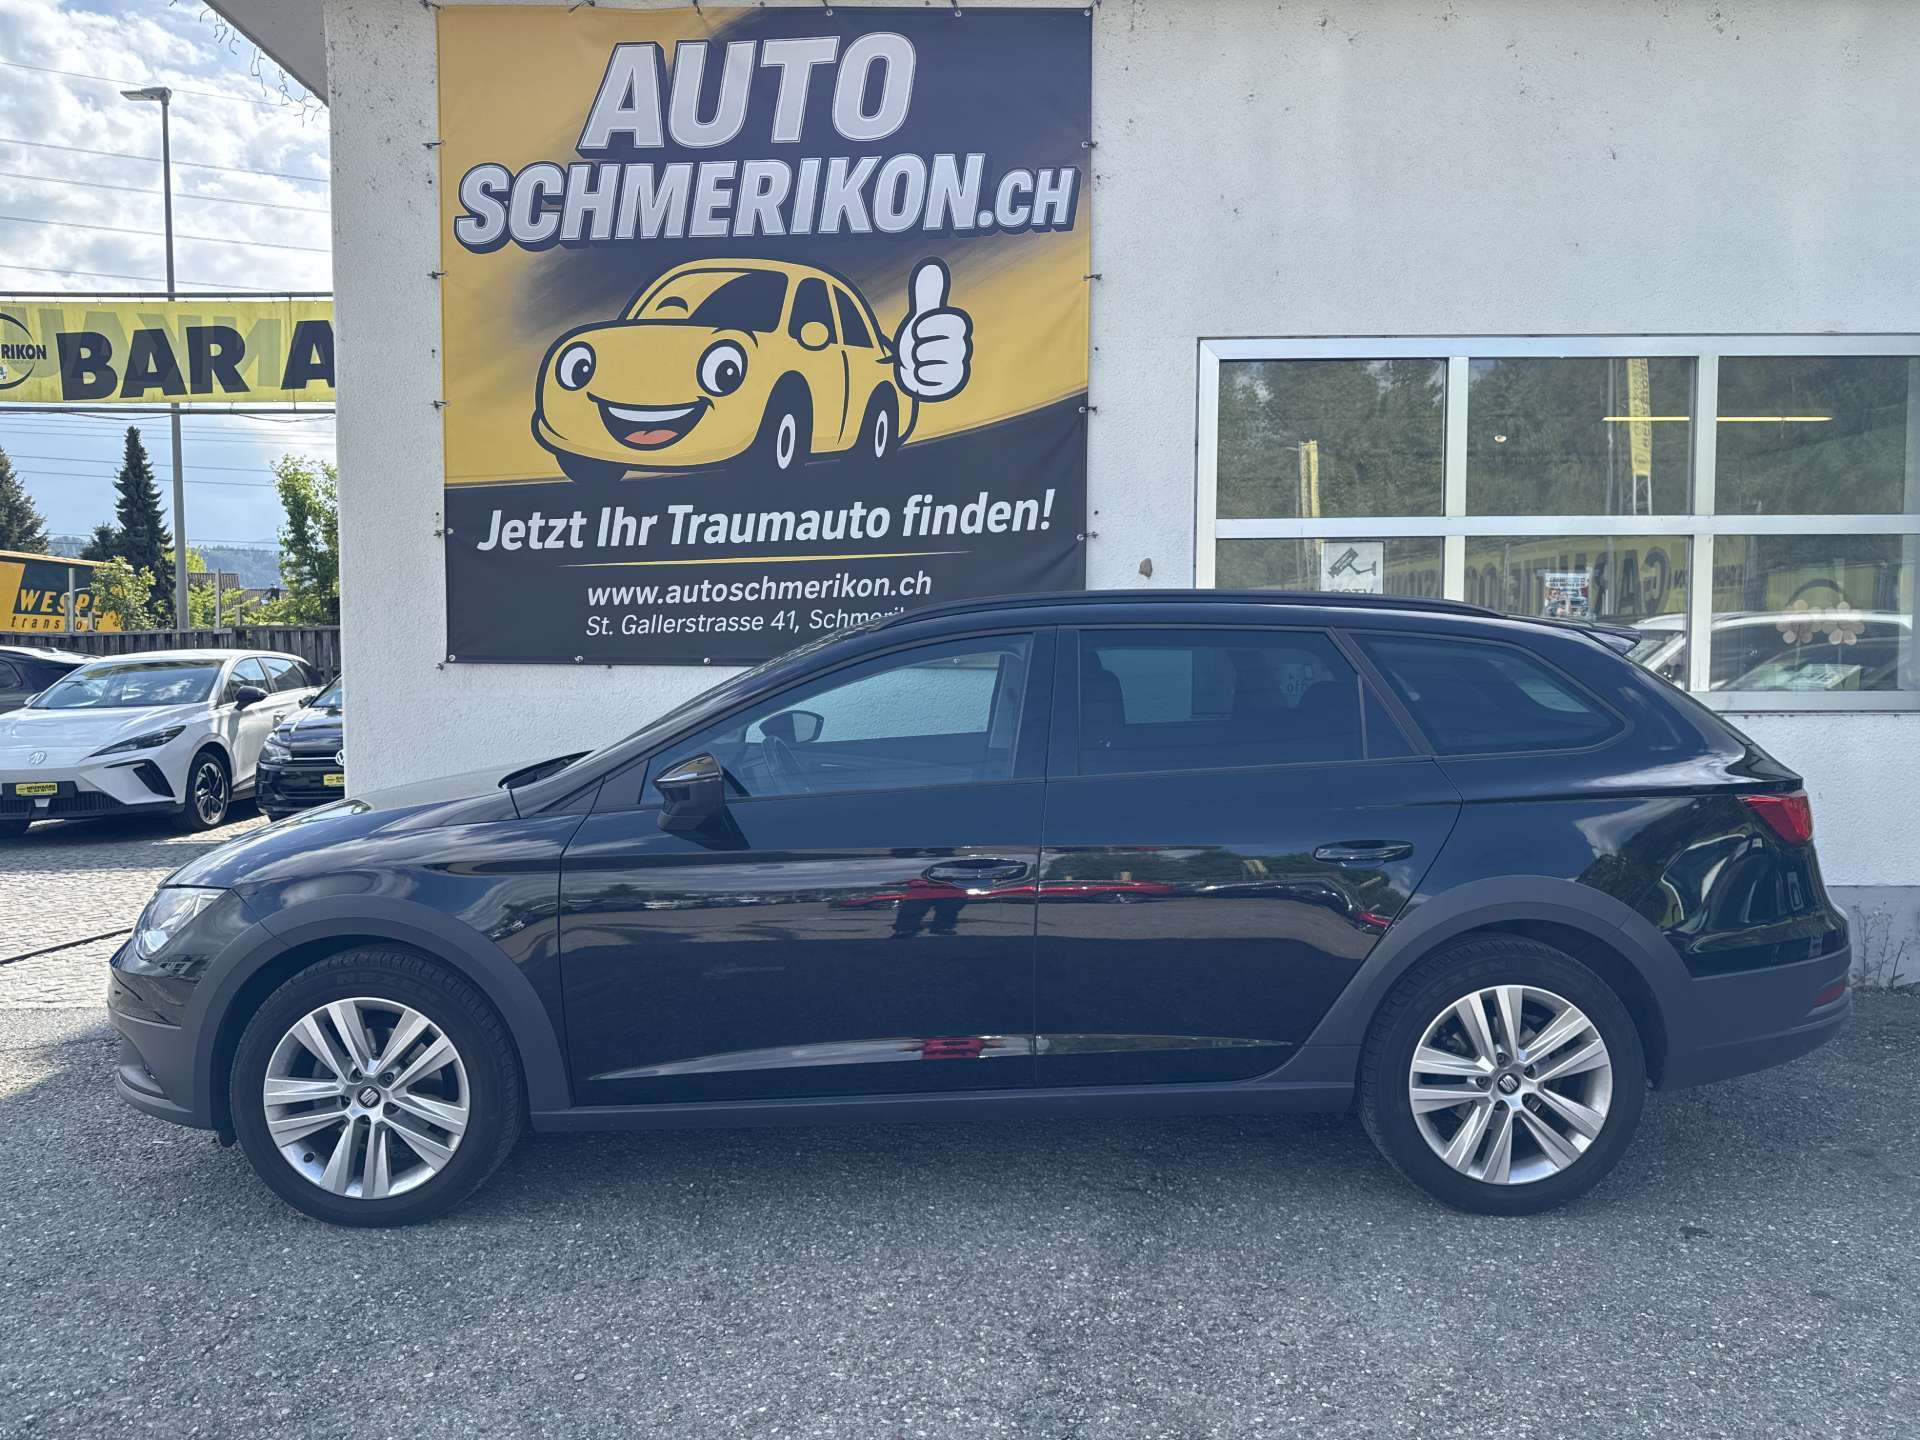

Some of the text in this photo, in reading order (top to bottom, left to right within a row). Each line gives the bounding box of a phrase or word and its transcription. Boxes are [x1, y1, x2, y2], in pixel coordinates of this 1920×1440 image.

[577, 31, 917, 152] AUTO
[455, 153, 1077, 250] SCHMERIKON.CH
[55, 325, 251, 401] BAR
[476, 488, 1056, 551] Jetzt Ihr Traumauto finden!
[586, 616, 614, 636] St.
[621, 613, 764, 636] Gallerstrasse
[770, 609, 800, 634] 41,
[587, 570, 932, 606] www.autoschmerikon.ch
